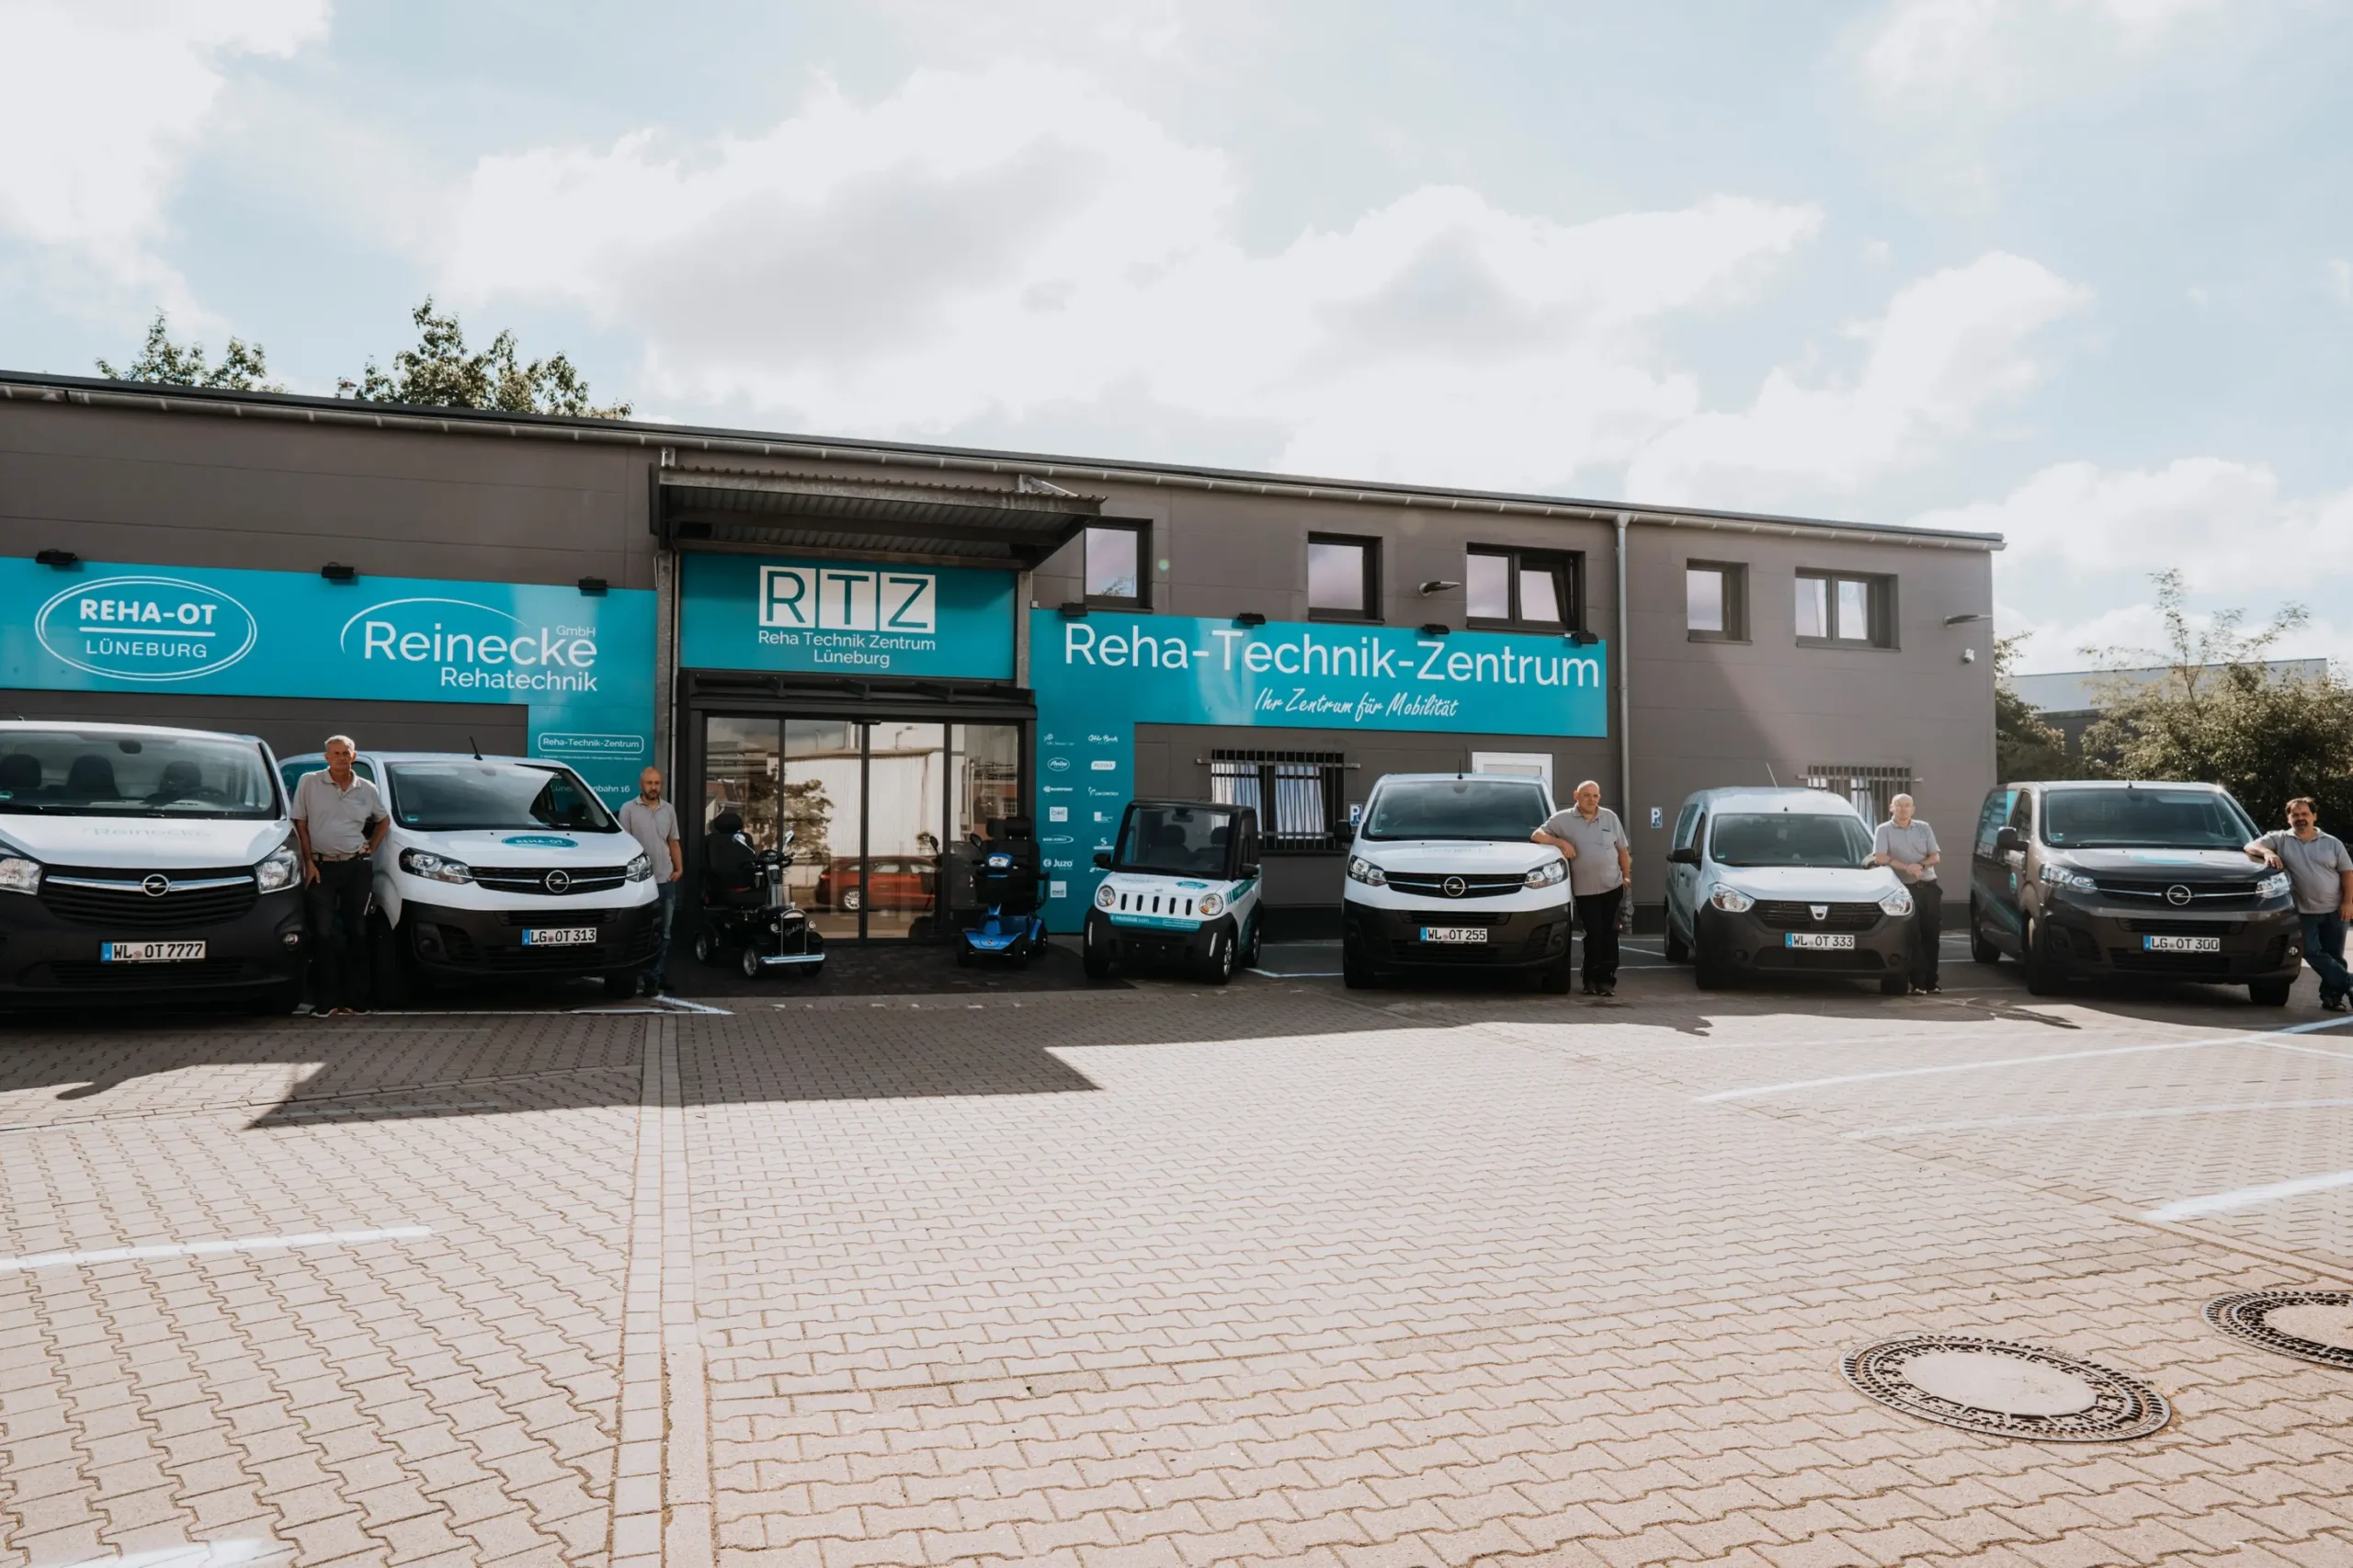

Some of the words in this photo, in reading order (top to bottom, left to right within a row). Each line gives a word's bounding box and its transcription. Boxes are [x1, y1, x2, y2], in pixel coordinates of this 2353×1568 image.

[767, 570, 928, 629] RTZ
[80, 598, 217, 625] REHA-OT
[556, 625, 596, 637] GmbH
[85, 638, 208, 658] LÜNEBURG
[364, 620, 597, 667] Reinecke
[758, 630, 799, 645] Reha
[802, 631, 865, 648] Technik
[869, 634, 936, 651] Zentrum
[813, 649, 890, 669] Lüneburg
[1064, 622, 1599, 688] Reha-Technik-Zentrum
[440, 666, 597, 691] Rehatechnik
[1255, 687, 1283, 711] Ihr
[1285, 687, 1353, 714] Zentrum
[1355, 691, 1383, 722] für
[1385, 692, 1460, 717] Mobilität
[542, 738, 640, 748] Reha-Technik-Zentrum
[591, 784, 619, 792] nbahn
[620, 785, 631, 793] 16
[1350, 805, 1360, 822] P
[1652, 809, 1661, 824] P
[1053, 858, 1074, 868] Juzo
[531, 931, 547, 943] LG
[555, 930, 571, 942] OT
[573, 929, 596, 942] 313
[1427, 929, 1441, 939] WL
[1449, 929, 1463, 940] OT
[1465, 929, 1486, 940] 255
[1793, 936, 1807, 946] WL
[1814, 936, 1830, 947] OT
[1832, 936, 1853, 947] 333
[113, 944, 132, 959] WL
[144, 944, 164, 958] OT
[167, 943, 203, 958] 7777
[2152, 937, 2167, 949] LG
[2176, 937, 2192, 949] OT
[2195, 938, 2219, 949] 300
